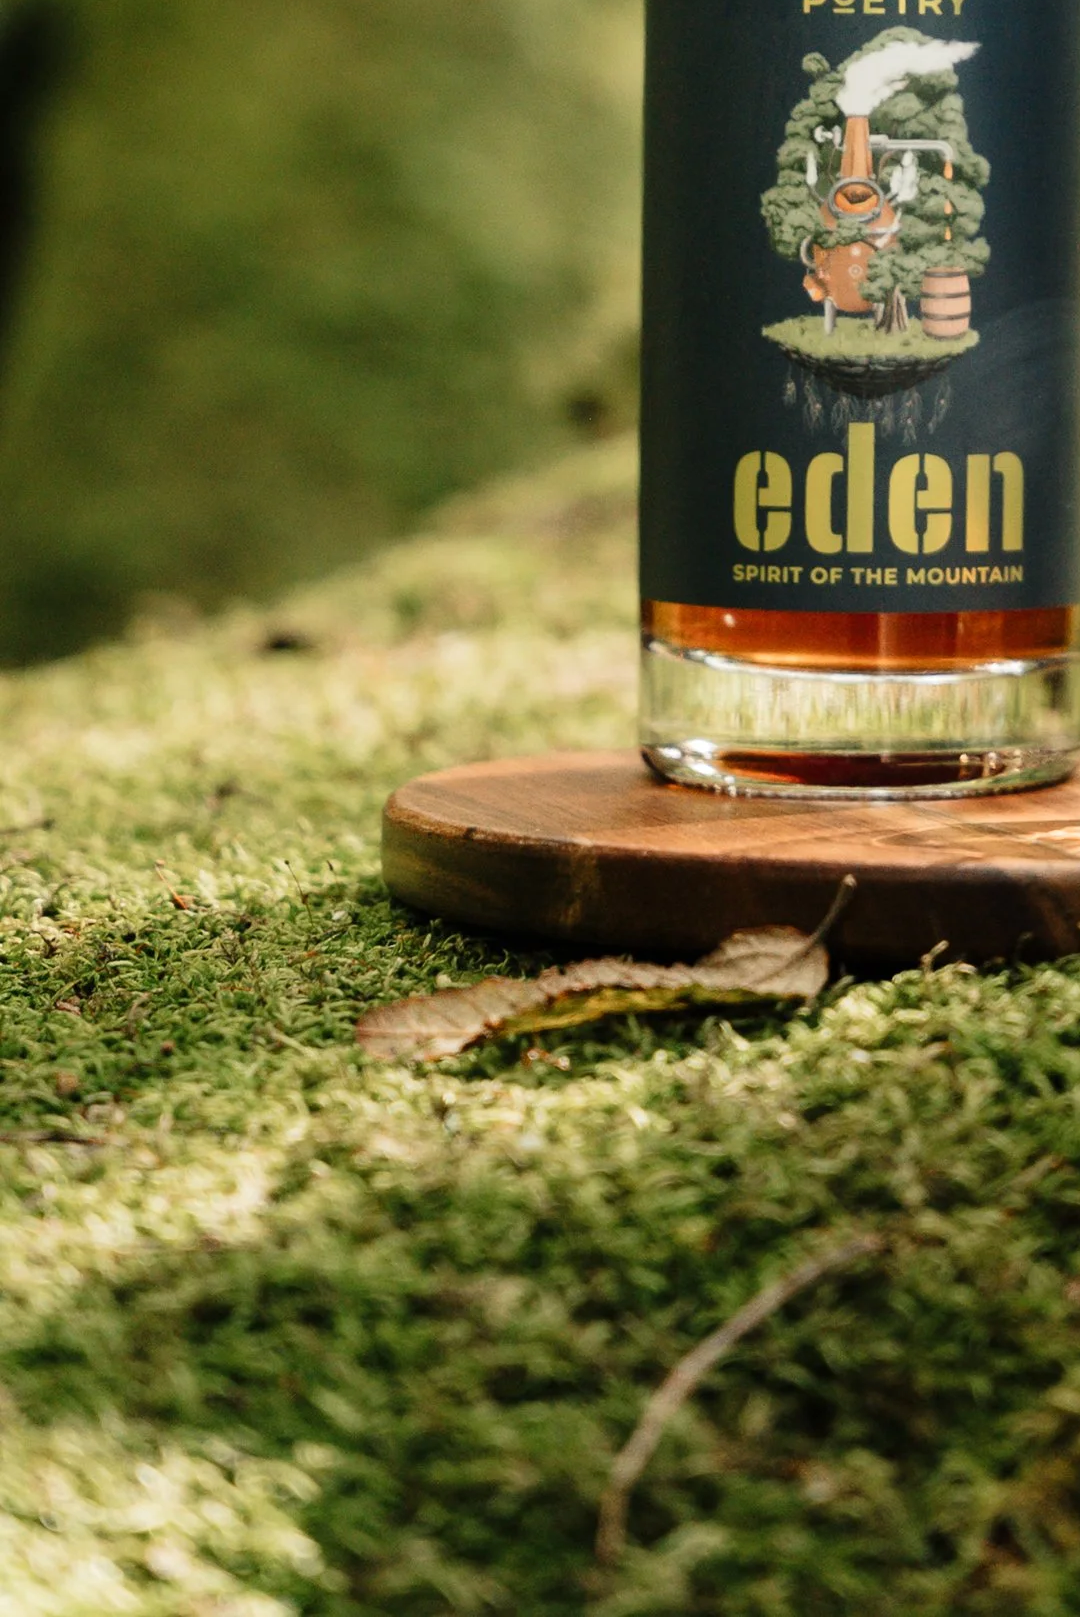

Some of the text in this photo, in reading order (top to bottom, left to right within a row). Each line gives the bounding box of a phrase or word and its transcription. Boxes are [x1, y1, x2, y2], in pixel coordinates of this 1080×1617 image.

[733, 422, 1024, 555] eden
[732, 563, 1024, 586] SPIRIT OF THE MOUNTAIN
